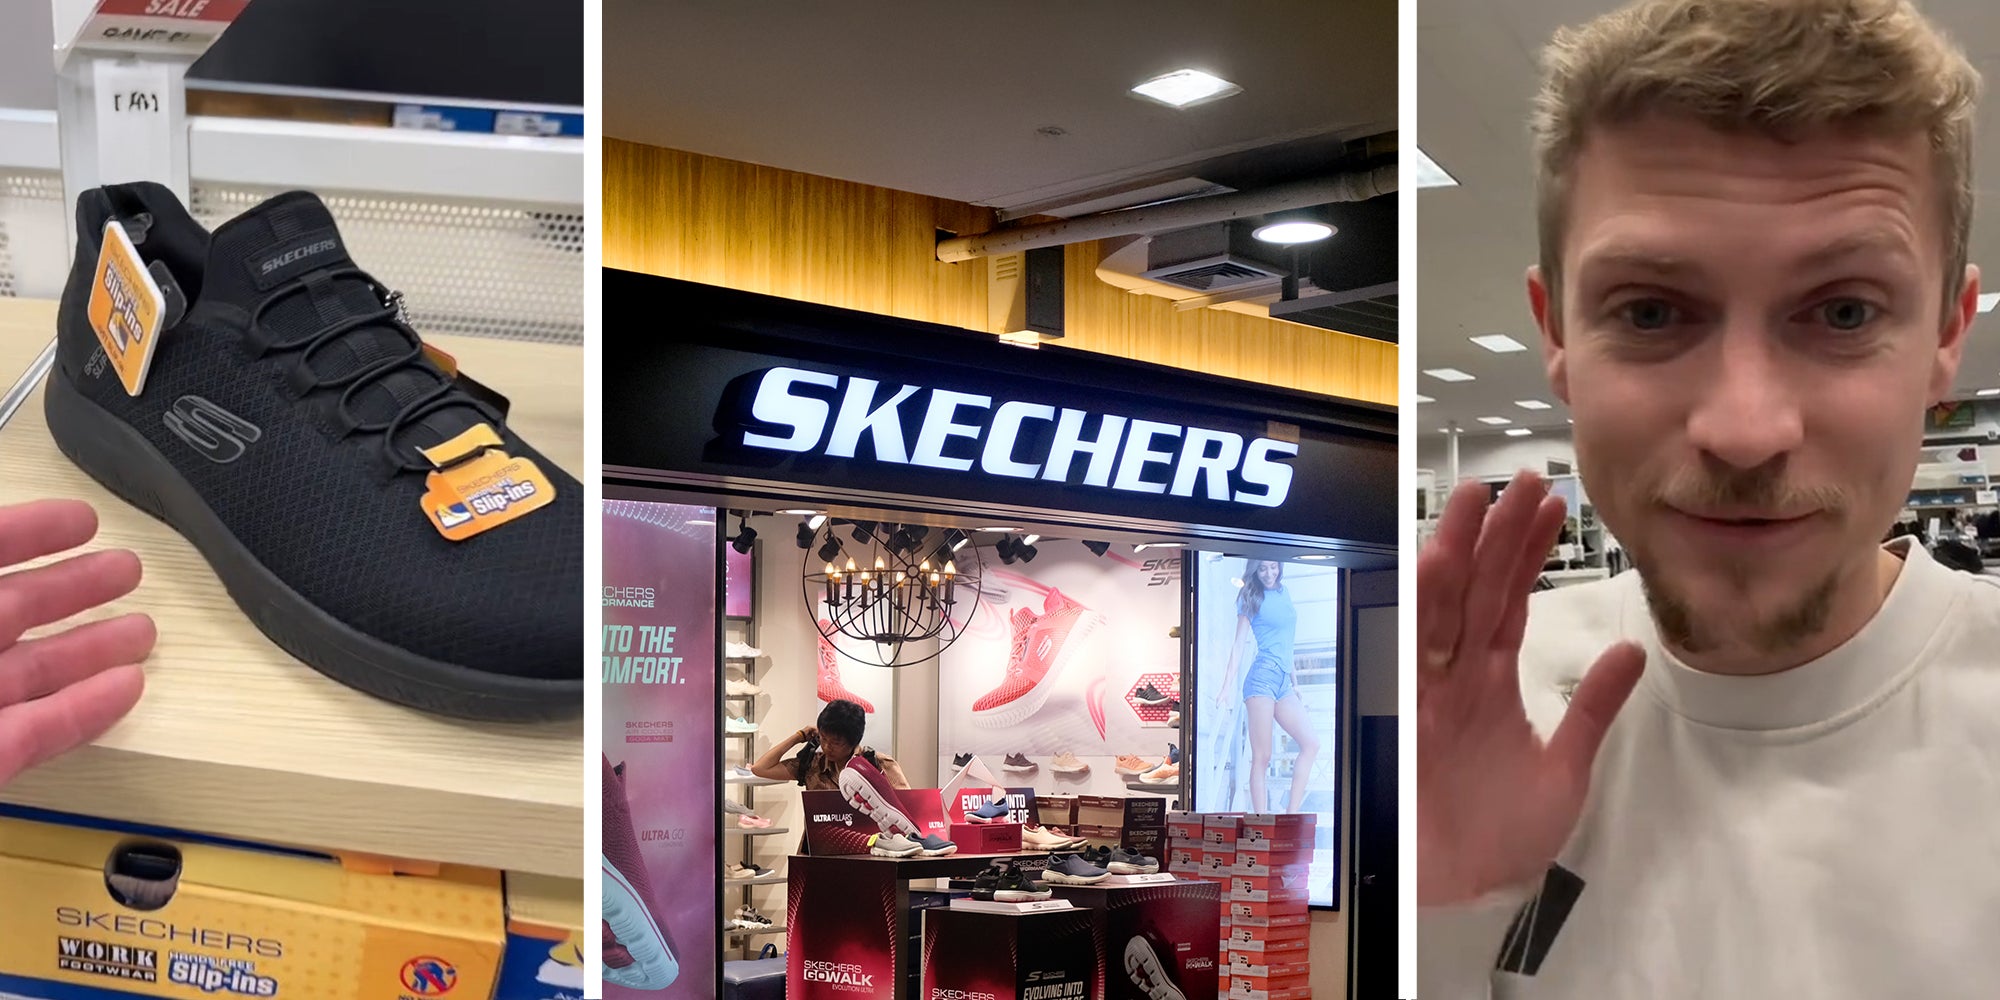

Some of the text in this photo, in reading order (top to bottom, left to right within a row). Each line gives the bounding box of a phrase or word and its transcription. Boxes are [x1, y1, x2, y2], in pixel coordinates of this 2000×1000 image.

[145, 0, 206, 17] SALE
[262, 240, 336, 275] SKECHERS
[742, 366, 1299, 508] SKECHERS
[470, 480, 536, 516] Slip-ins
[639, 626, 677, 653] THE
[813, 814, 831, 822] ULTRA
[928, 821, 944, 829] ULTRA
[1018, 809, 1030, 823] OF
[641, 830, 670, 841] ULTRA
[56, 907, 282, 957] SKECHERS
[60, 938, 155, 968] WORK
[60, 960, 155, 982] FOOTWEAR
[803, 960, 862, 973] SKECHERS
[170, 962, 276, 995] Slip-ins
[803, 969, 874, 987] GOWALK
[832, 984, 860, 993] EVOLUTION
[931, 988, 995, 1000] SKECHERS
[1023, 981, 1083, 1000] EVOLVING INTO
